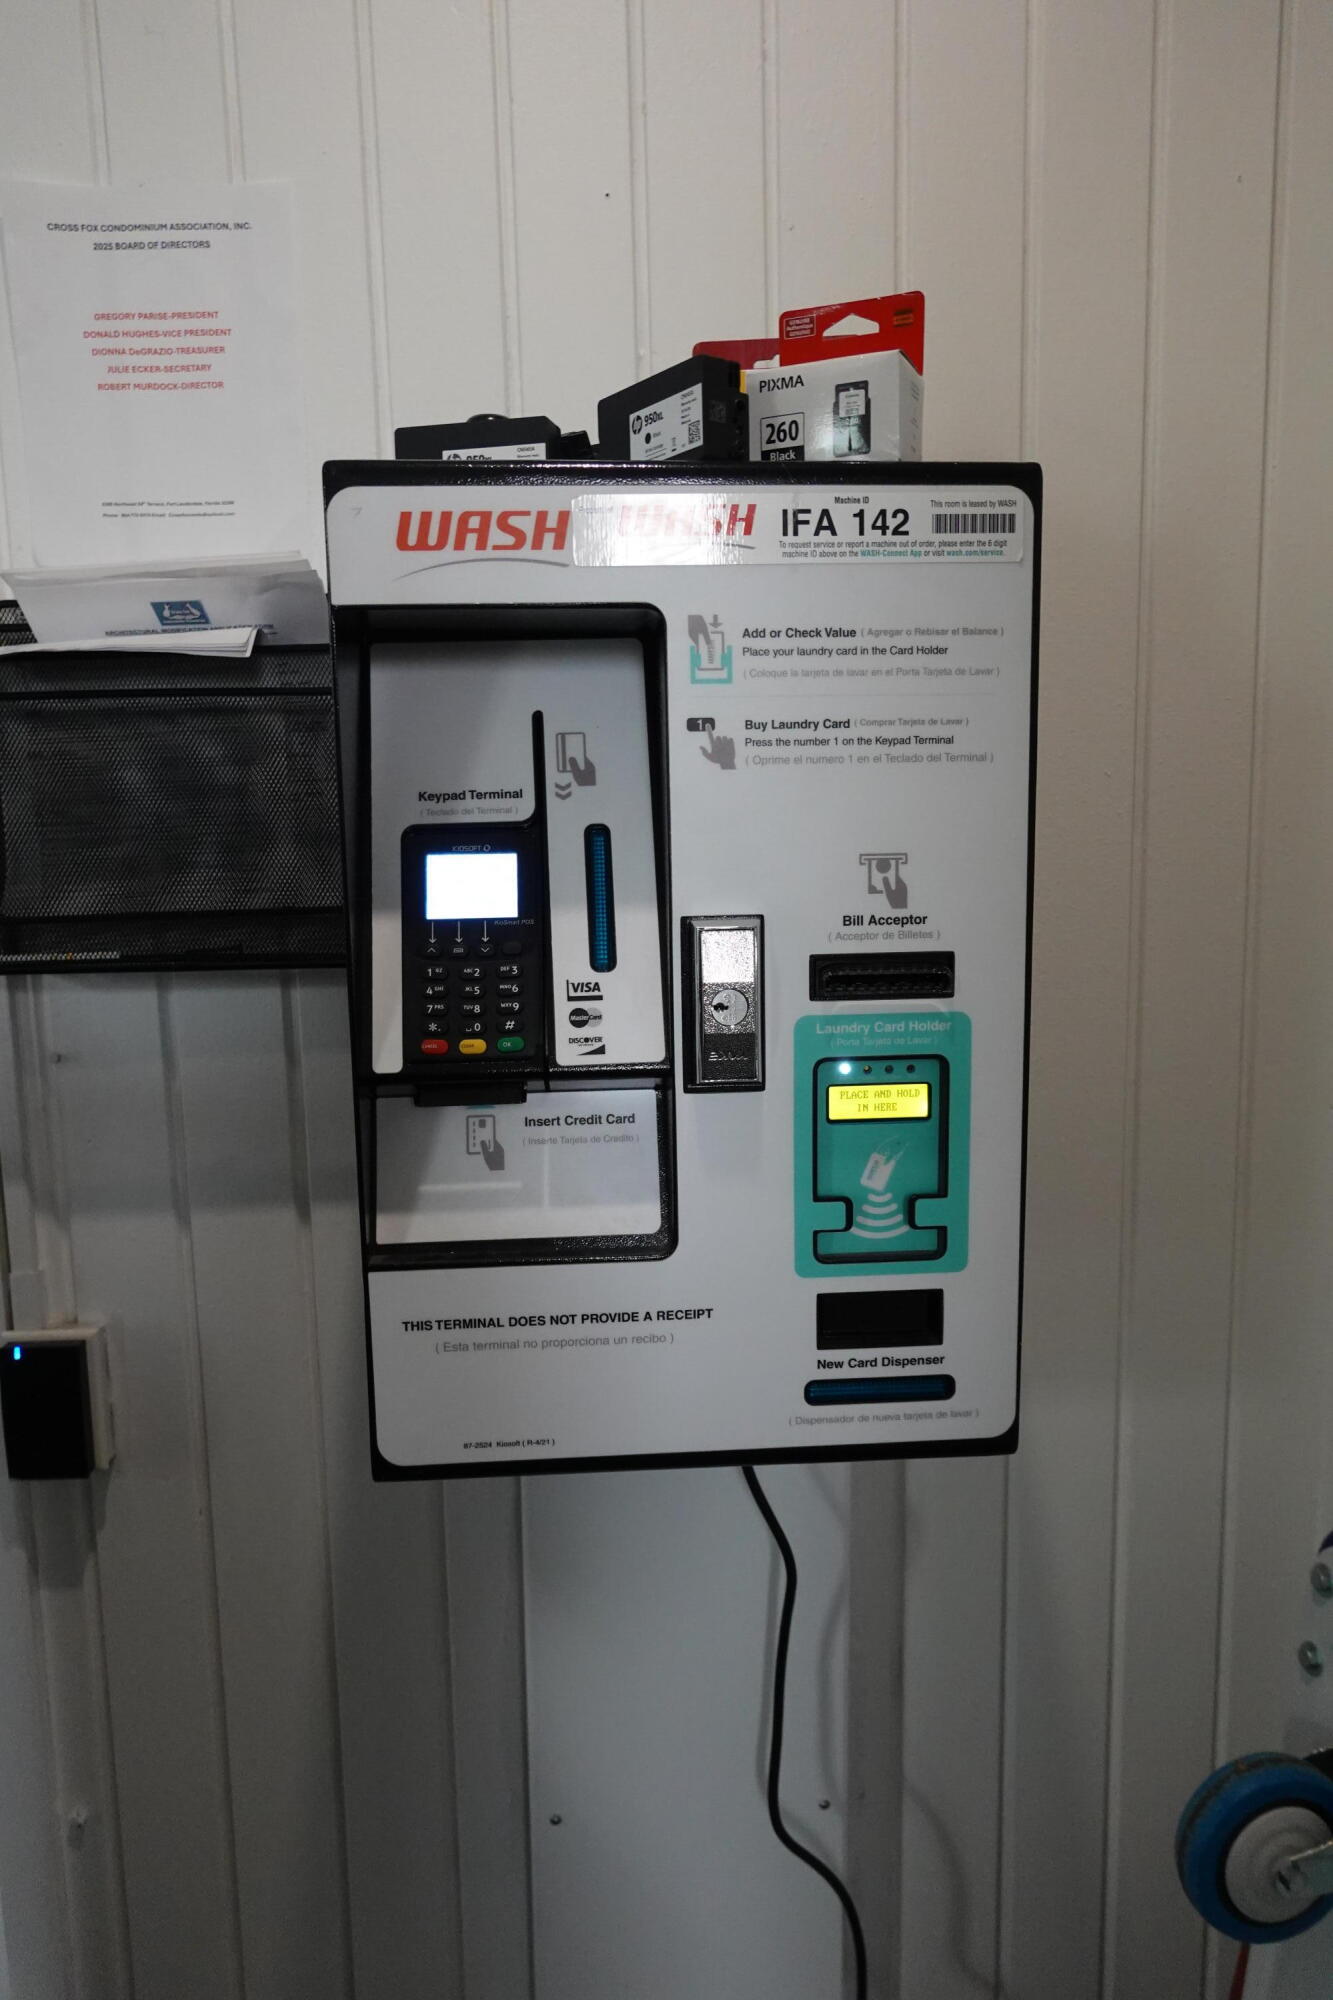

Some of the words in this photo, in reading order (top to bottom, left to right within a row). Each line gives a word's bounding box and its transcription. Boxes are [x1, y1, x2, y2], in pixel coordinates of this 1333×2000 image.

[47, 223, 80, 232] CROSS
[81, 224, 99, 232] FOX
[101, 224, 168, 232] CONDOMINIUM
[170, 222, 232, 230] ASSOCIATION,
[93, 242, 114, 250] 2025
[114, 241, 146, 250] BOARD
[146, 241, 158, 249] OF
[160, 240, 211, 249] DIRECTORS
[94, 312, 136, 320] GREGORY
[137, 311, 218, 320] PARISE-PRESIDENT
[84, 330, 121, 338] DONALD
[122, 329, 183, 338] HUGHES-VICE
[184, 328, 232, 336] PRESIDENT
[108, 365, 130, 374] JULIE
[132, 364, 212, 373] ECKER-SECRETARY
[98, 383, 132, 391] ROBERT
[133, 381, 224, 391] MURDOCK-DIRECTOR
[760, 374, 804, 393] PIXMA
[766, 420, 799, 445] 260
[770, 450, 796, 462] Black
[834, 496, 861, 504] Machine
[862, 496, 870, 504] ID
[989, 500, 996, 508] by
[782, 508, 838, 536] IFA
[853, 508, 910, 536] 142
[396, 510, 570, 552] WASH
[788, 541, 812, 549] request
[844, 540, 864, 549] report
[918, 540, 936, 548] order,
[938, 540, 958, 548] please
[993, 539, 1007, 548] digit
[910, 550, 922, 558] App
[742, 628, 766, 638] Add
[769, 629, 781, 638] or
[785, 627, 822, 638] Check
[824, 627, 856, 637] Value
[742, 646, 770, 656] Place
[772, 648, 794, 658] your
[796, 646, 834, 657] laundry
[835, 646, 858, 655] card
[860, 646, 869, 655] in
[871, 646, 887, 655] the
[889, 645, 914, 655] Card
[916, 645, 948, 655] Holder
[696, 719, 703, 731] 1
[744, 719, 767, 732] Buy
[771, 719, 819, 731] Laundry
[822, 718, 850, 728] Card
[744, 738, 772, 746] Press
[775, 737, 791, 746] the
[793, 738, 830, 746] number
[834, 736, 838, 745] 1
[856, 736, 872, 745] the
[874, 736, 911, 747] Keypad
[913, 735, 954, 744] Terminal
[752, 754, 790, 766] Oprime
[793, 754, 803, 764] el
[805, 756, 845, 764] numero
[848, 754, 853, 763] 1
[856, 755, 870, 763] en
[872, 754, 882, 763] el
[884, 753, 924, 763] Teclado
[926, 752, 942, 762] del
[944, 752, 987, 762] Terminal
[418, 790, 466, 804] Keypad
[468, 789, 523, 800] Terminal
[842, 914, 864, 926] Bill
[867, 914, 928, 926] Acceptor
[835, 932, 879, 941] Acceptor
[882, 931, 894, 939] de
[898, 930, 934, 939] Billetes
[428, 968, 432, 976] 1
[474, 968, 480, 976] 2
[512, 966, 518, 974] 3
[426, 986, 432, 995] 4
[474, 986, 480, 994] 5
[512, 984, 518, 992] 6
[570, 982, 601, 992] VISA
[427, 1004, 433, 1013] 7
[474, 1004, 480, 1013] 8
[512, 1002, 519, 1010] 9
[474, 1023, 480, 1031] 0
[505, 1020, 515, 1030] #
[816, 1023, 870, 1035] Laundry
[874, 1022, 904, 1032] Card
[909, 1020, 952, 1031] Holder
[840, 1090, 868, 1100] PLACE
[874, 1089, 892, 1098] AND
[897, 1089, 920, 1098] HOLD
[858, 1104, 868, 1112] IN
[874, 1103, 897, 1112] HERE
[524, 1116, 560, 1127] Insert
[564, 1114, 602, 1126] Credit
[605, 1113, 635, 1124] Card
[402, 1320, 433, 1332] THIS
[435, 1317, 505, 1330] TERMINAL
[508, 1315, 546, 1327] DOES
[550, 1314, 578, 1325] NOT
[581, 1311, 640, 1324] PROVIDE
[643, 1311, 653, 1321] A
[656, 1308, 714, 1321] RECEIPT
[442, 1340, 469, 1352] Esta
[472, 1340, 520, 1351] terminal
[522, 1340, 538, 1349] no
[540, 1337, 610, 1349] proporciona
[613, 1336, 628, 1344] un
[631, 1333, 667, 1344] recibo
[816, 1359, 845, 1369] New
[847, 1357, 878, 1368] Card
[880, 1355, 946, 1367] Dispenser
[794, 1414, 854, 1426] Dispensador
[856, 1414, 870, 1423] de
[872, 1414, 901, 1422] nueva
[902, 1412, 933, 1422] tarjeta
[935, 1410, 948, 1419] de
[949, 1409, 973, 1418] lavar
